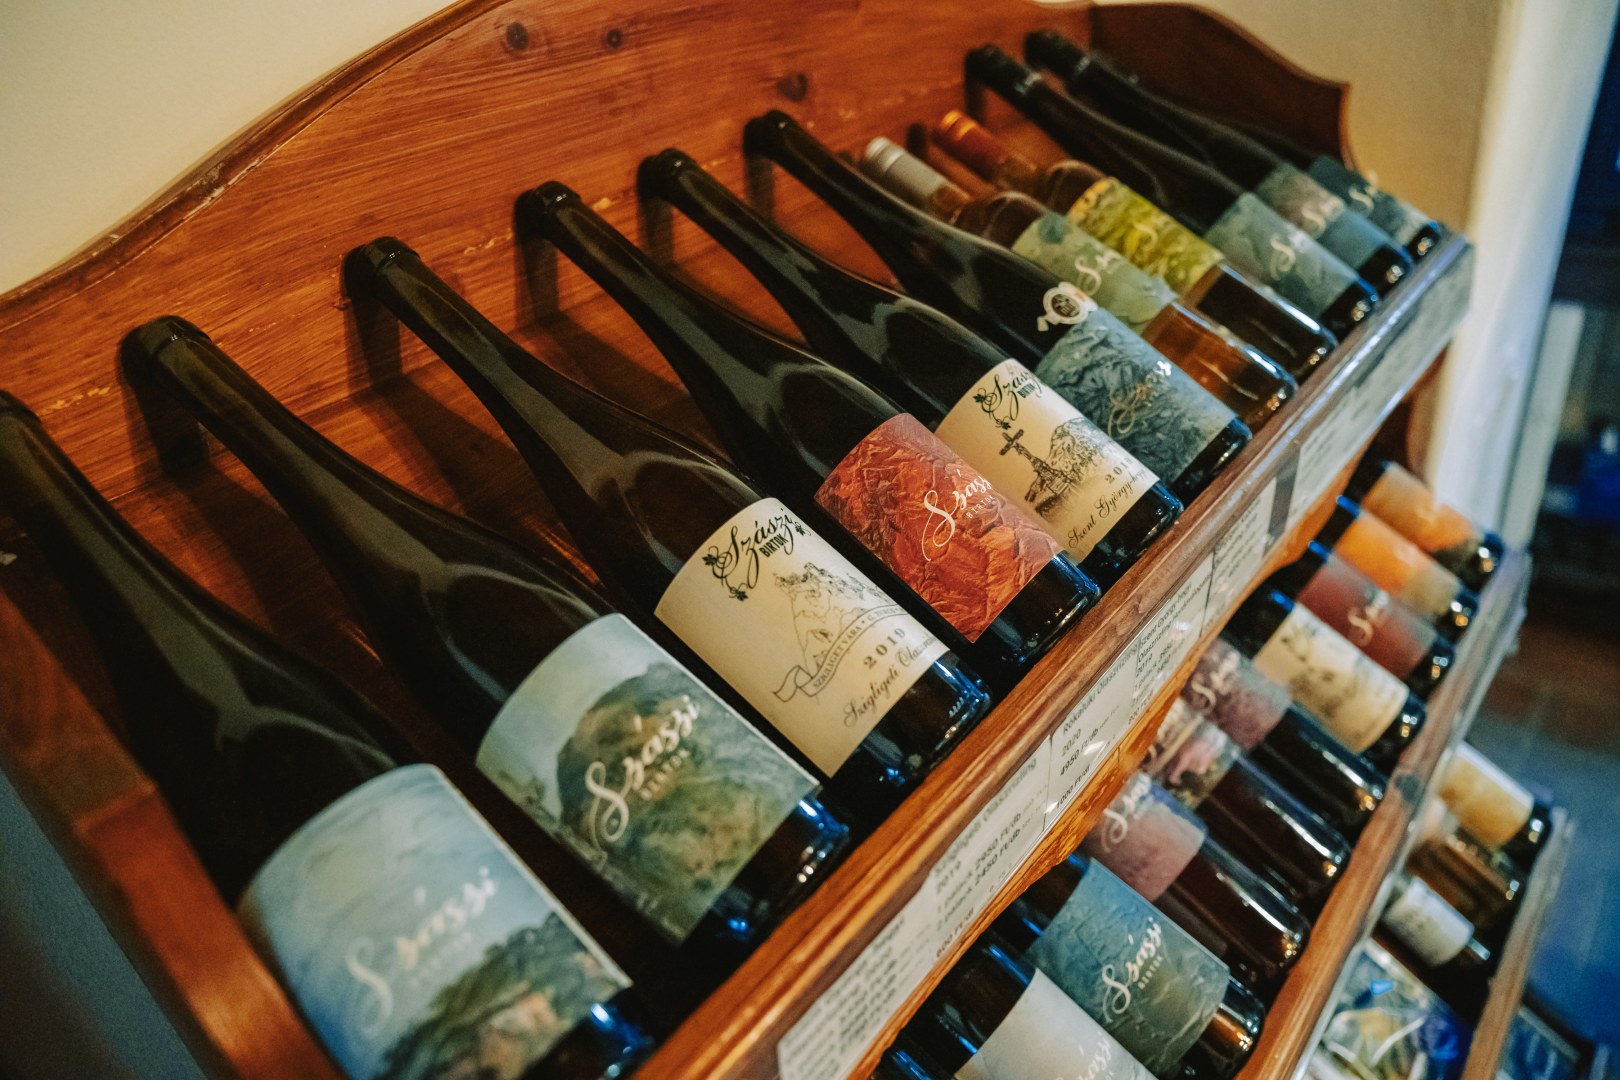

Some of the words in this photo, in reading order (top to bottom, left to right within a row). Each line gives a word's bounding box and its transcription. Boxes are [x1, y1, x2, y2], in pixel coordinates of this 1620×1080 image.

[965, 494, 996, 519] BIRTOK
[758, 533, 789, 558] BIRTOK
[1067, 514, 1097, 549] Szent
[711, 507, 795, 590] Szászi
[863, 627, 906, 670] 2019
[1139, 624, 1157, 649] Szent
[1136, 652, 1153, 677] 2019
[843, 664, 899, 728] Szigligeti
[1061, 728, 1082, 757] 2020
[1060, 749, 1080, 776] 4950
[1101, 915, 1163, 1024] Szászi
